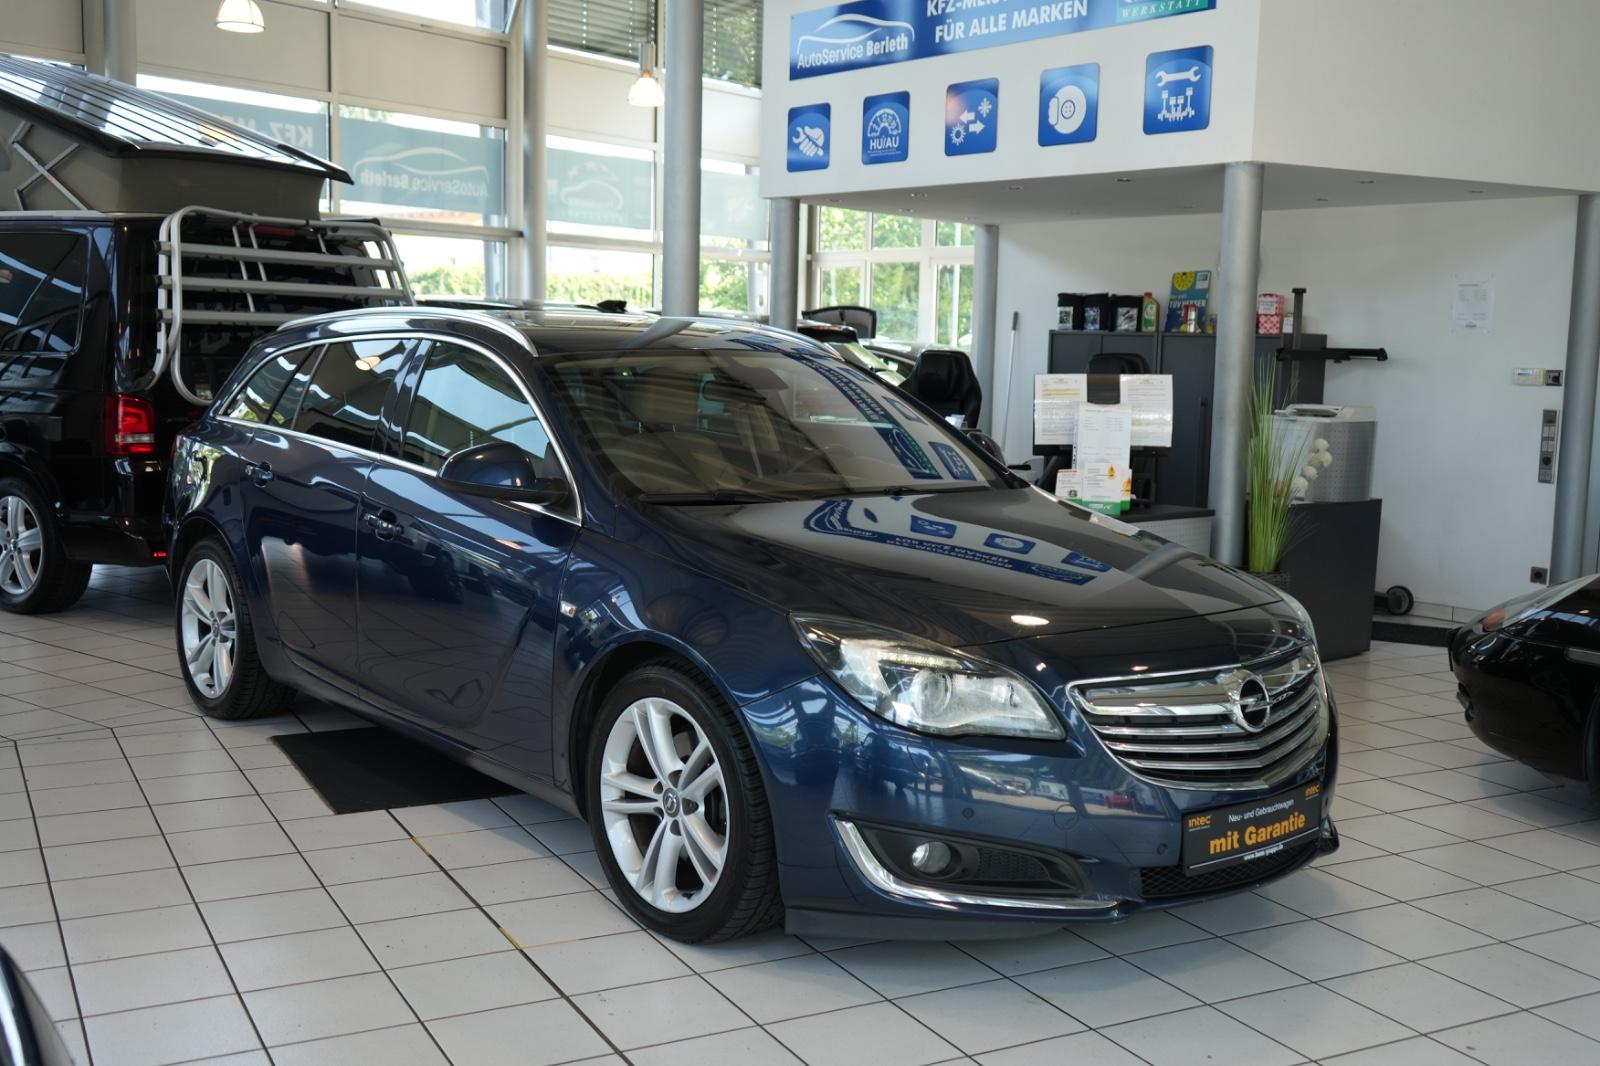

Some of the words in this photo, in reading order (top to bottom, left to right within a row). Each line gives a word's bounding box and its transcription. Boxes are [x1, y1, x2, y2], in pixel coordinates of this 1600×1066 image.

[935, 19, 965, 44] FÜR
[969, 13, 1007, 37] ALLE
[1012, 0, 1088, 29] MARKEN
[797, 44, 864, 69] AutoService
[866, 33, 908, 56] Berleth
[870, 136, 900, 150] HU/AU
[1188, 815, 1212, 828] intec
[1228, 813, 1243, 823] Neu-
[1243, 808, 1255, 820] und
[1255, 799, 1295, 816] Gebrauchtwagen
[1209, 830, 1240, 855] mit
[1244, 811, 1306, 846] Garantie
